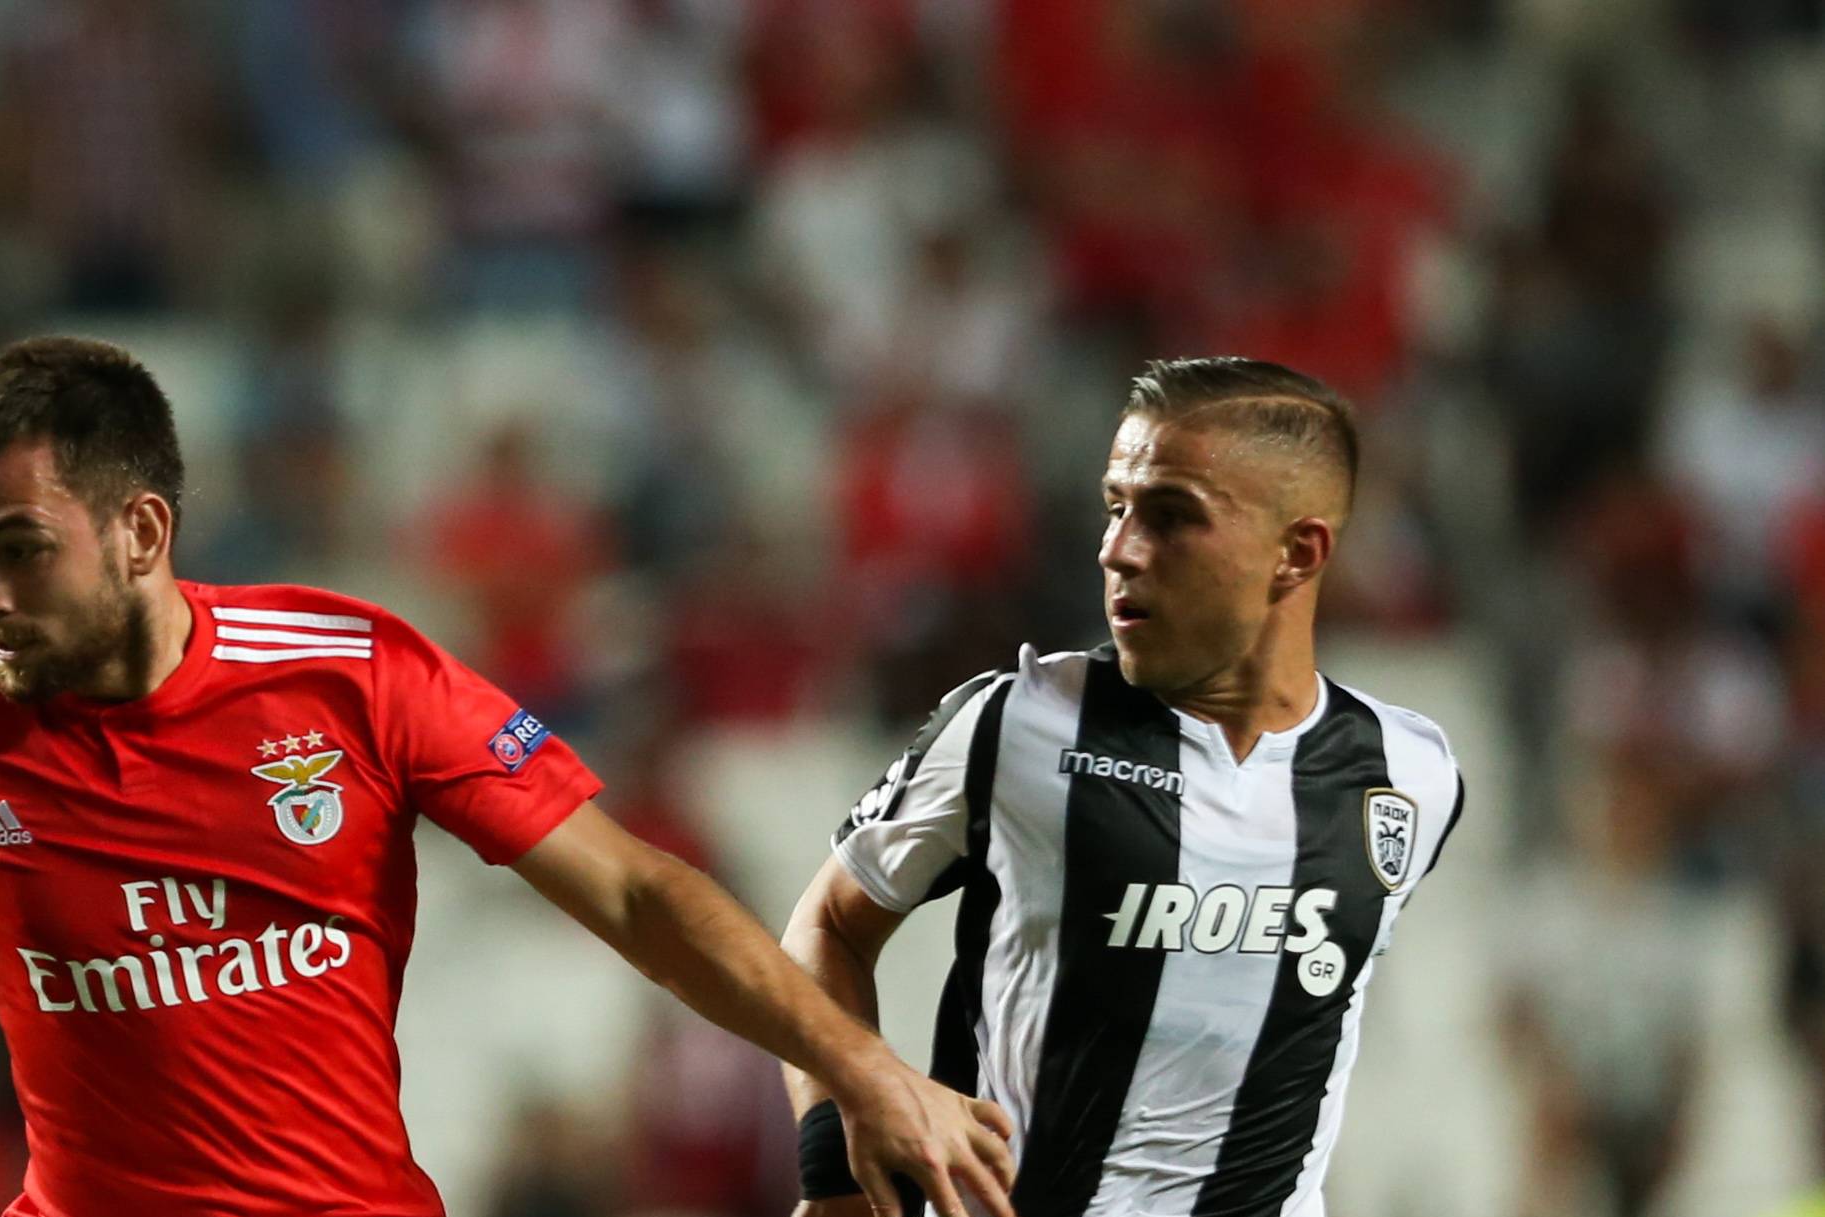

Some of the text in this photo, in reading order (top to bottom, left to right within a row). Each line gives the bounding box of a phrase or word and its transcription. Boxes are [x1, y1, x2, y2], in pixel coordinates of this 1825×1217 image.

[514, 714, 544, 744] RE
[1060, 749, 1184, 796] macron
[120, 876, 227, 932] Fly
[16, 914, 351, 1013] Emirates
[1308, 960, 1335, 981] GR
